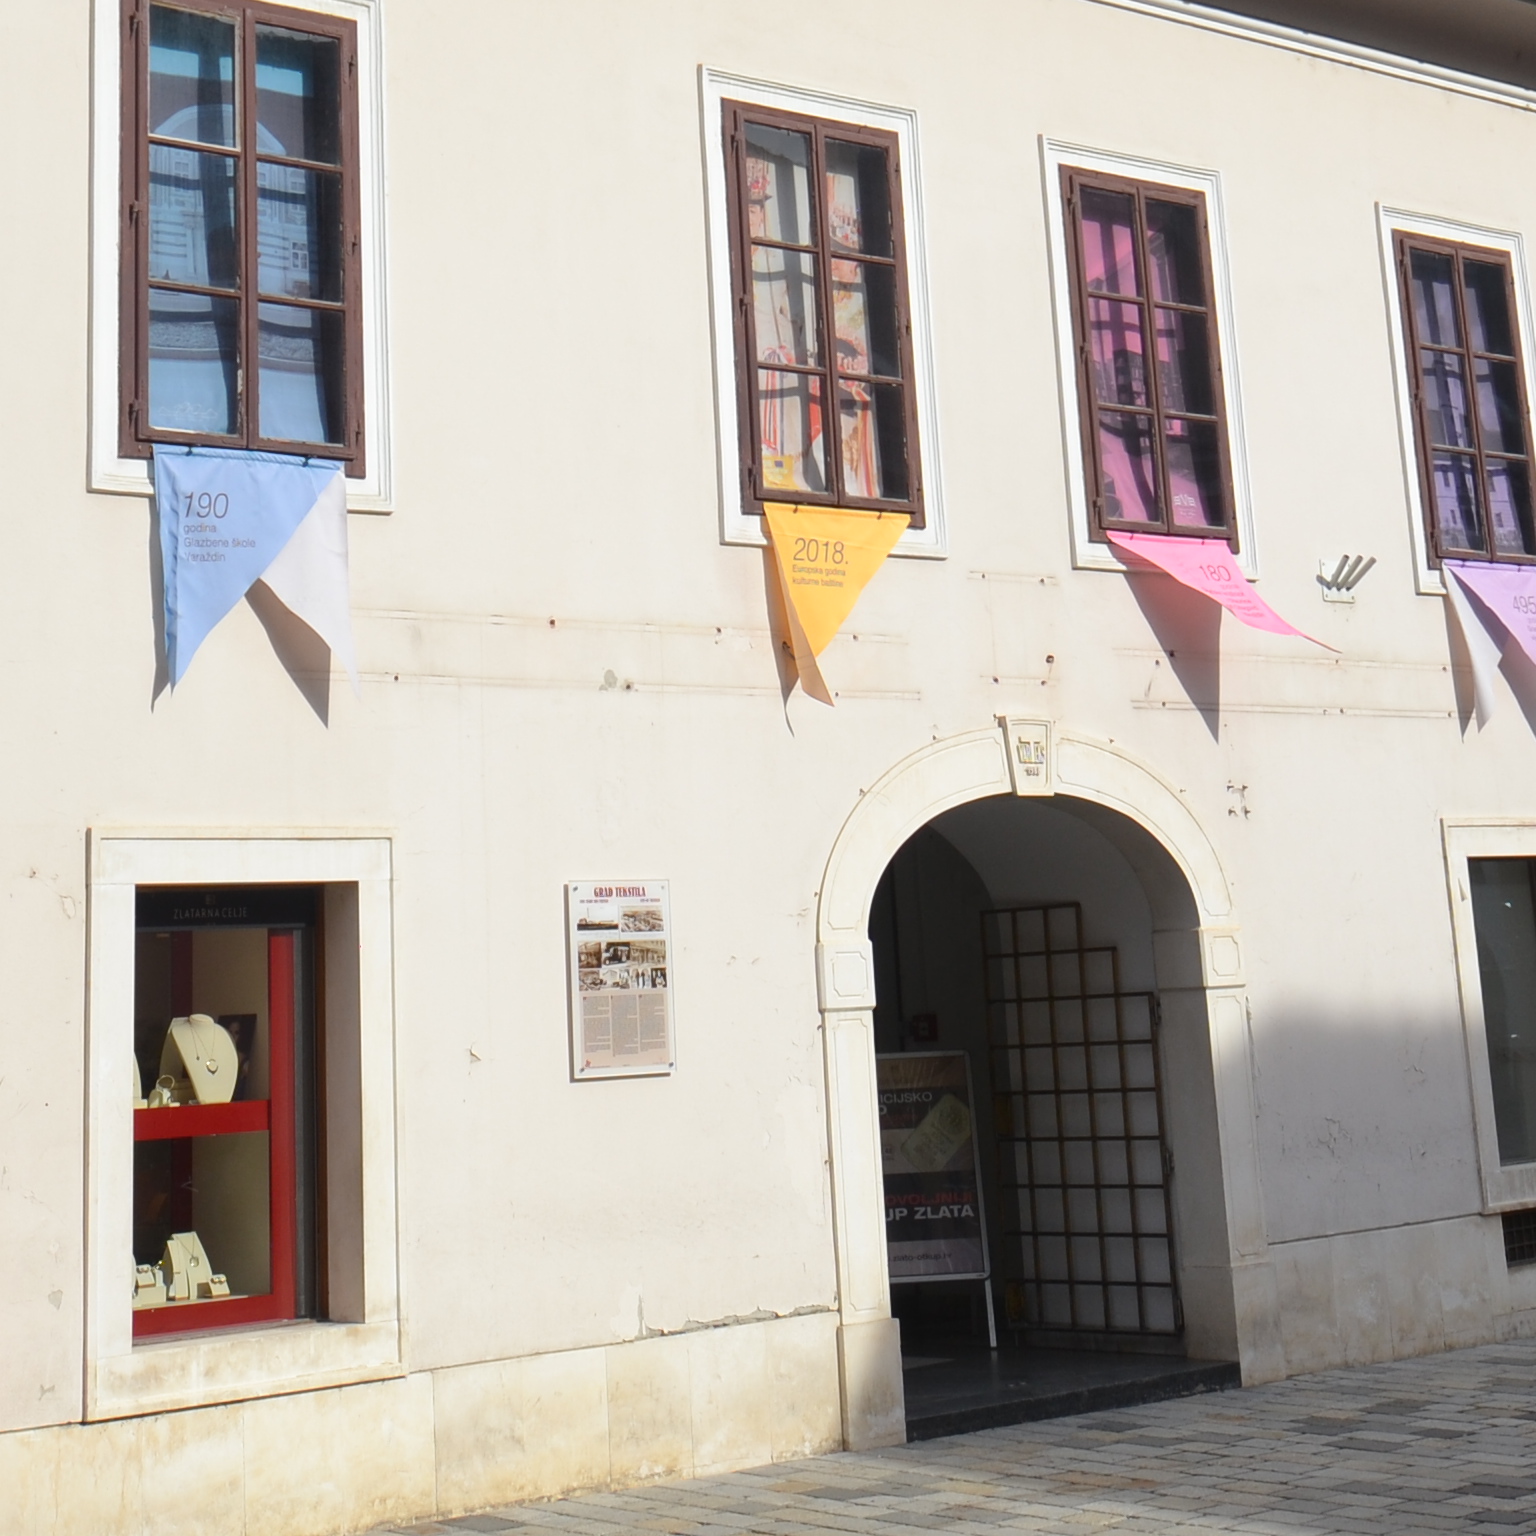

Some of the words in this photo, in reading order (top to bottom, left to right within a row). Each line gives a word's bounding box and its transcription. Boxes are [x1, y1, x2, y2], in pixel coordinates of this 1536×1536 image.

[184, 491, 230, 519] 190
[183, 523, 217, 535] godina
[183, 537, 229, 548] Glazbene
[792, 537, 850, 565] 2018.
[1199, 564, 1232, 582] 180
[593, 886, 613, 898] GRAD
[615, 886, 646, 897] TEKSTILA
[173, 908, 220, 920] ZLATARNA
[221, 907, 247, 918] CELJE
[914, 1204, 975, 1219] ZLATA
